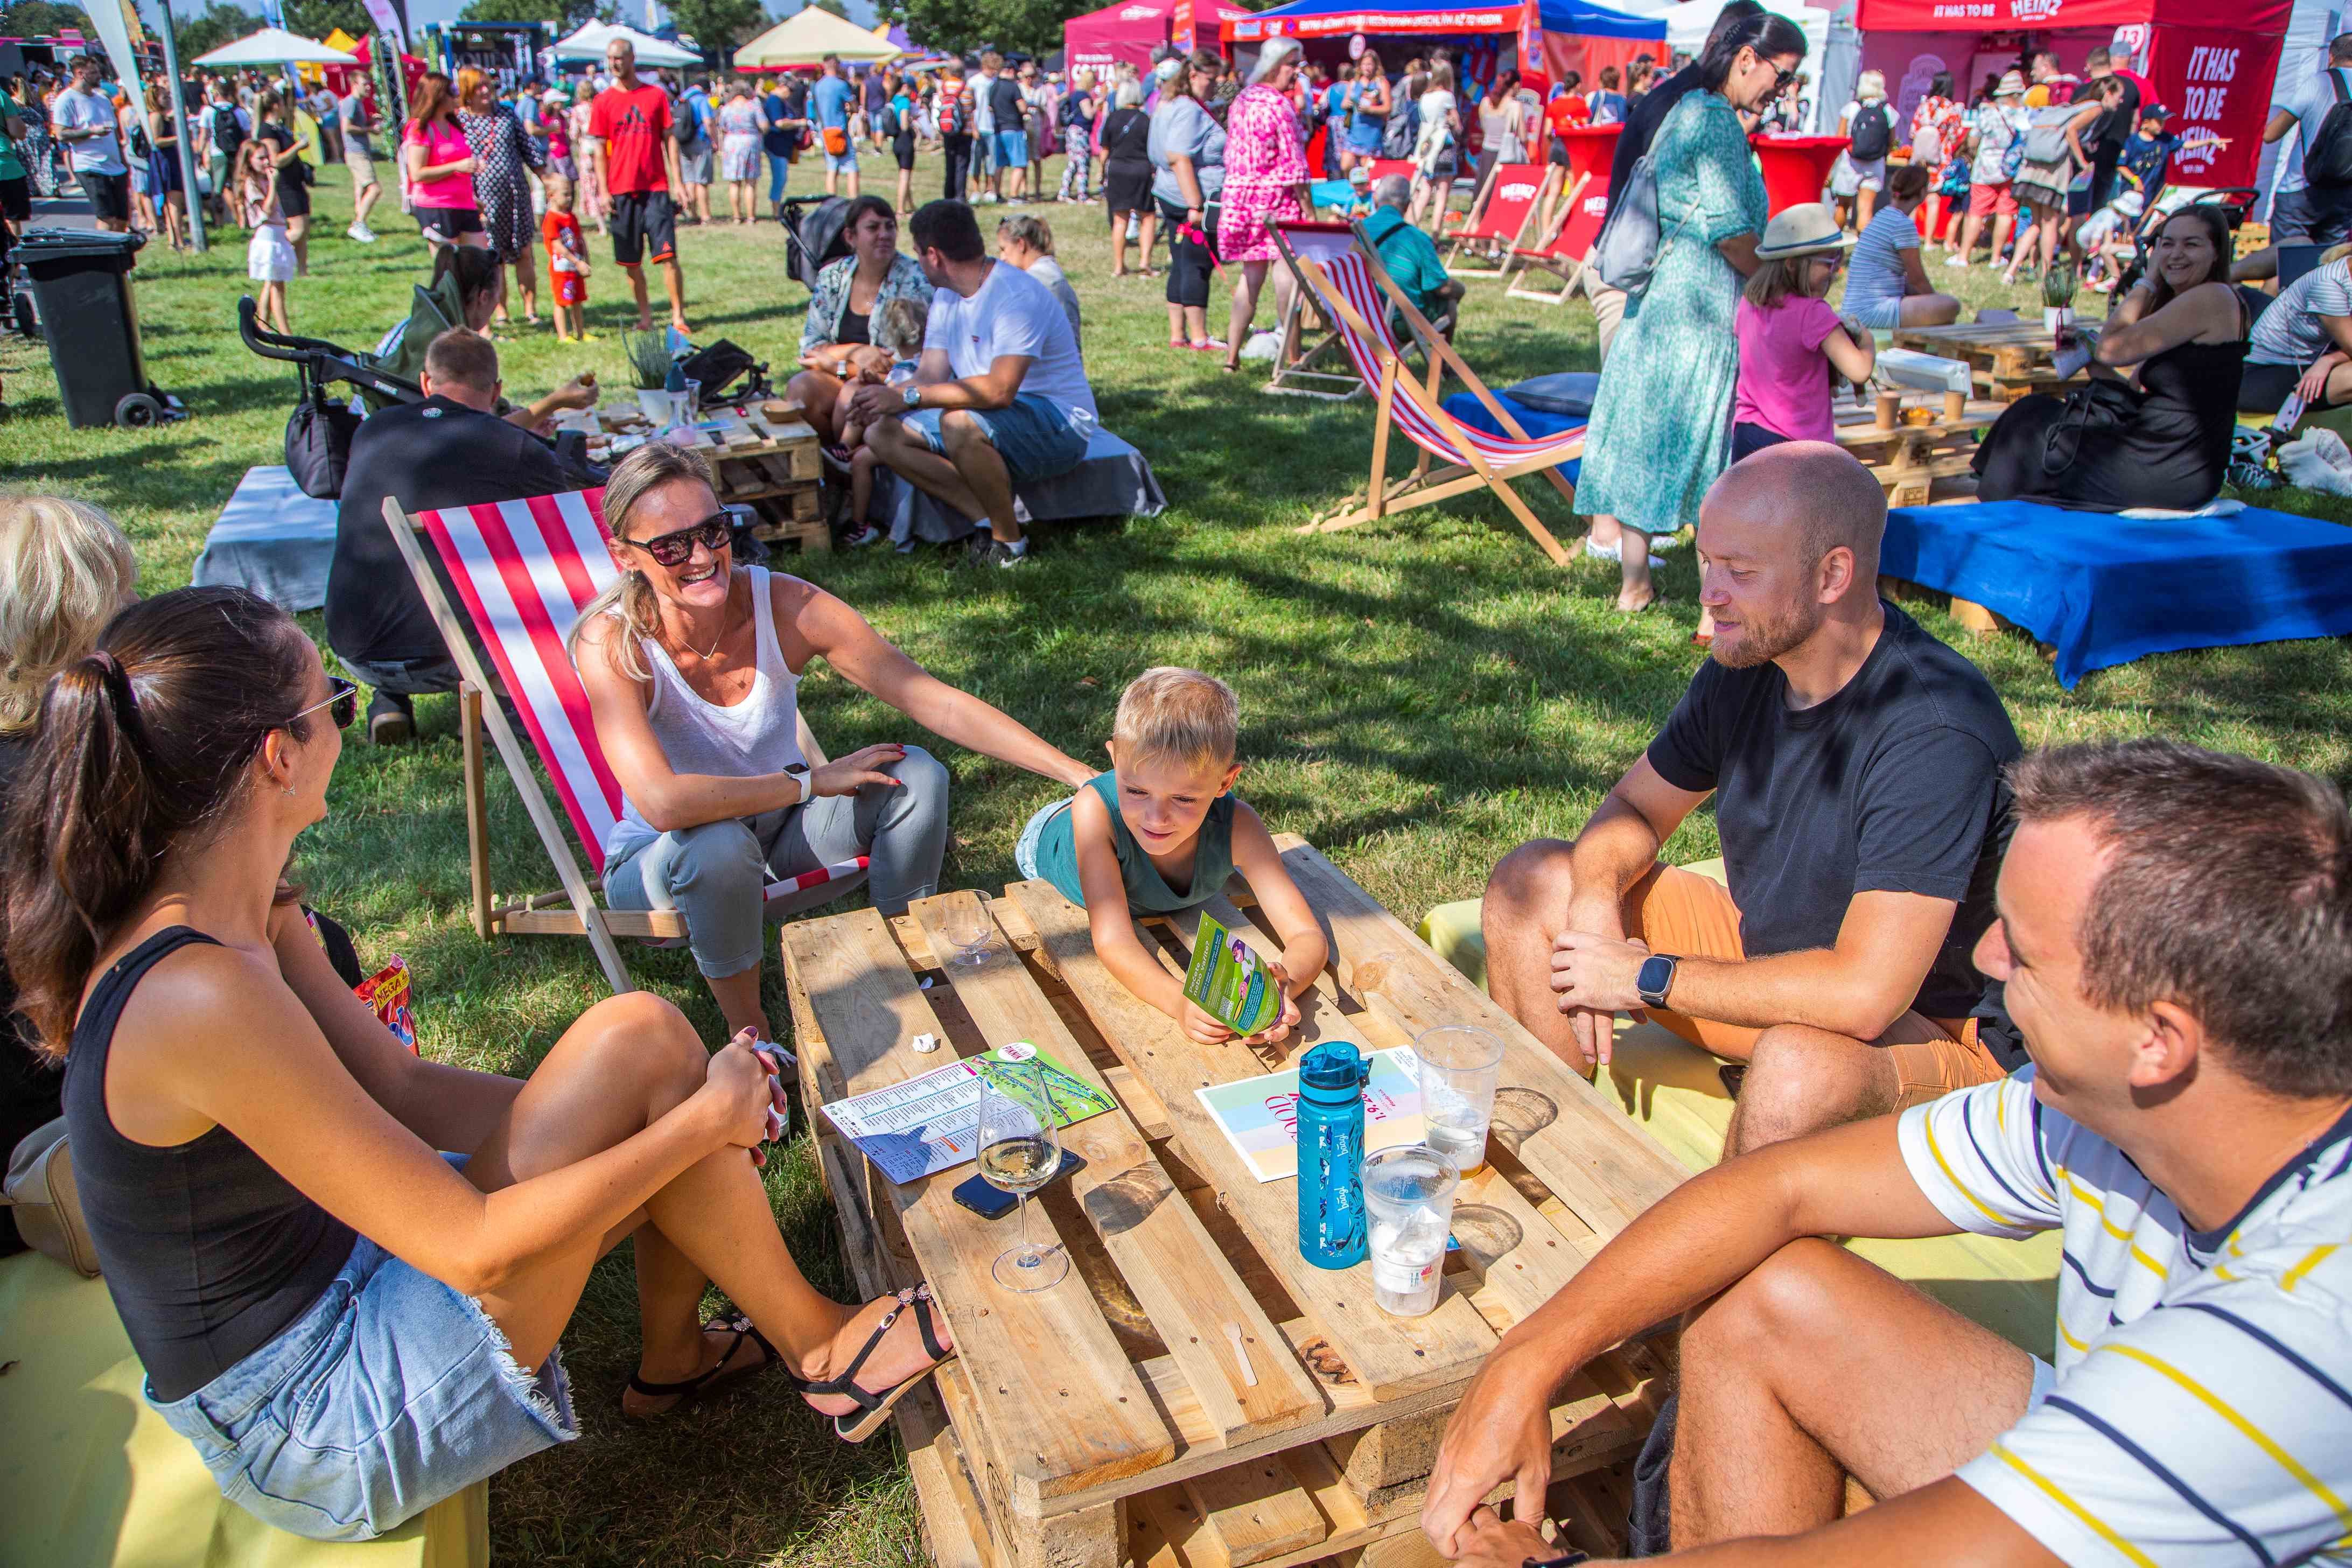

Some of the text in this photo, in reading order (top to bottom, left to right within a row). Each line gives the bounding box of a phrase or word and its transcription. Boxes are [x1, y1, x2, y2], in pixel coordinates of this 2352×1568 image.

[1944, 4, 1966, 17] HAS
[1966, 4, 1981, 17] TO
[1981, 3, 1996, 17] BE
[2011, 0, 2063, 18] HEINZ
[2122, 30, 2139, 45] 13
[2186, 46, 2240, 82] IT HAS
[2182, 86, 2228, 121] TO BE
[377, 978, 402, 1004] MEGA
[1003, 1046, 1024, 1060] PIKNIK
